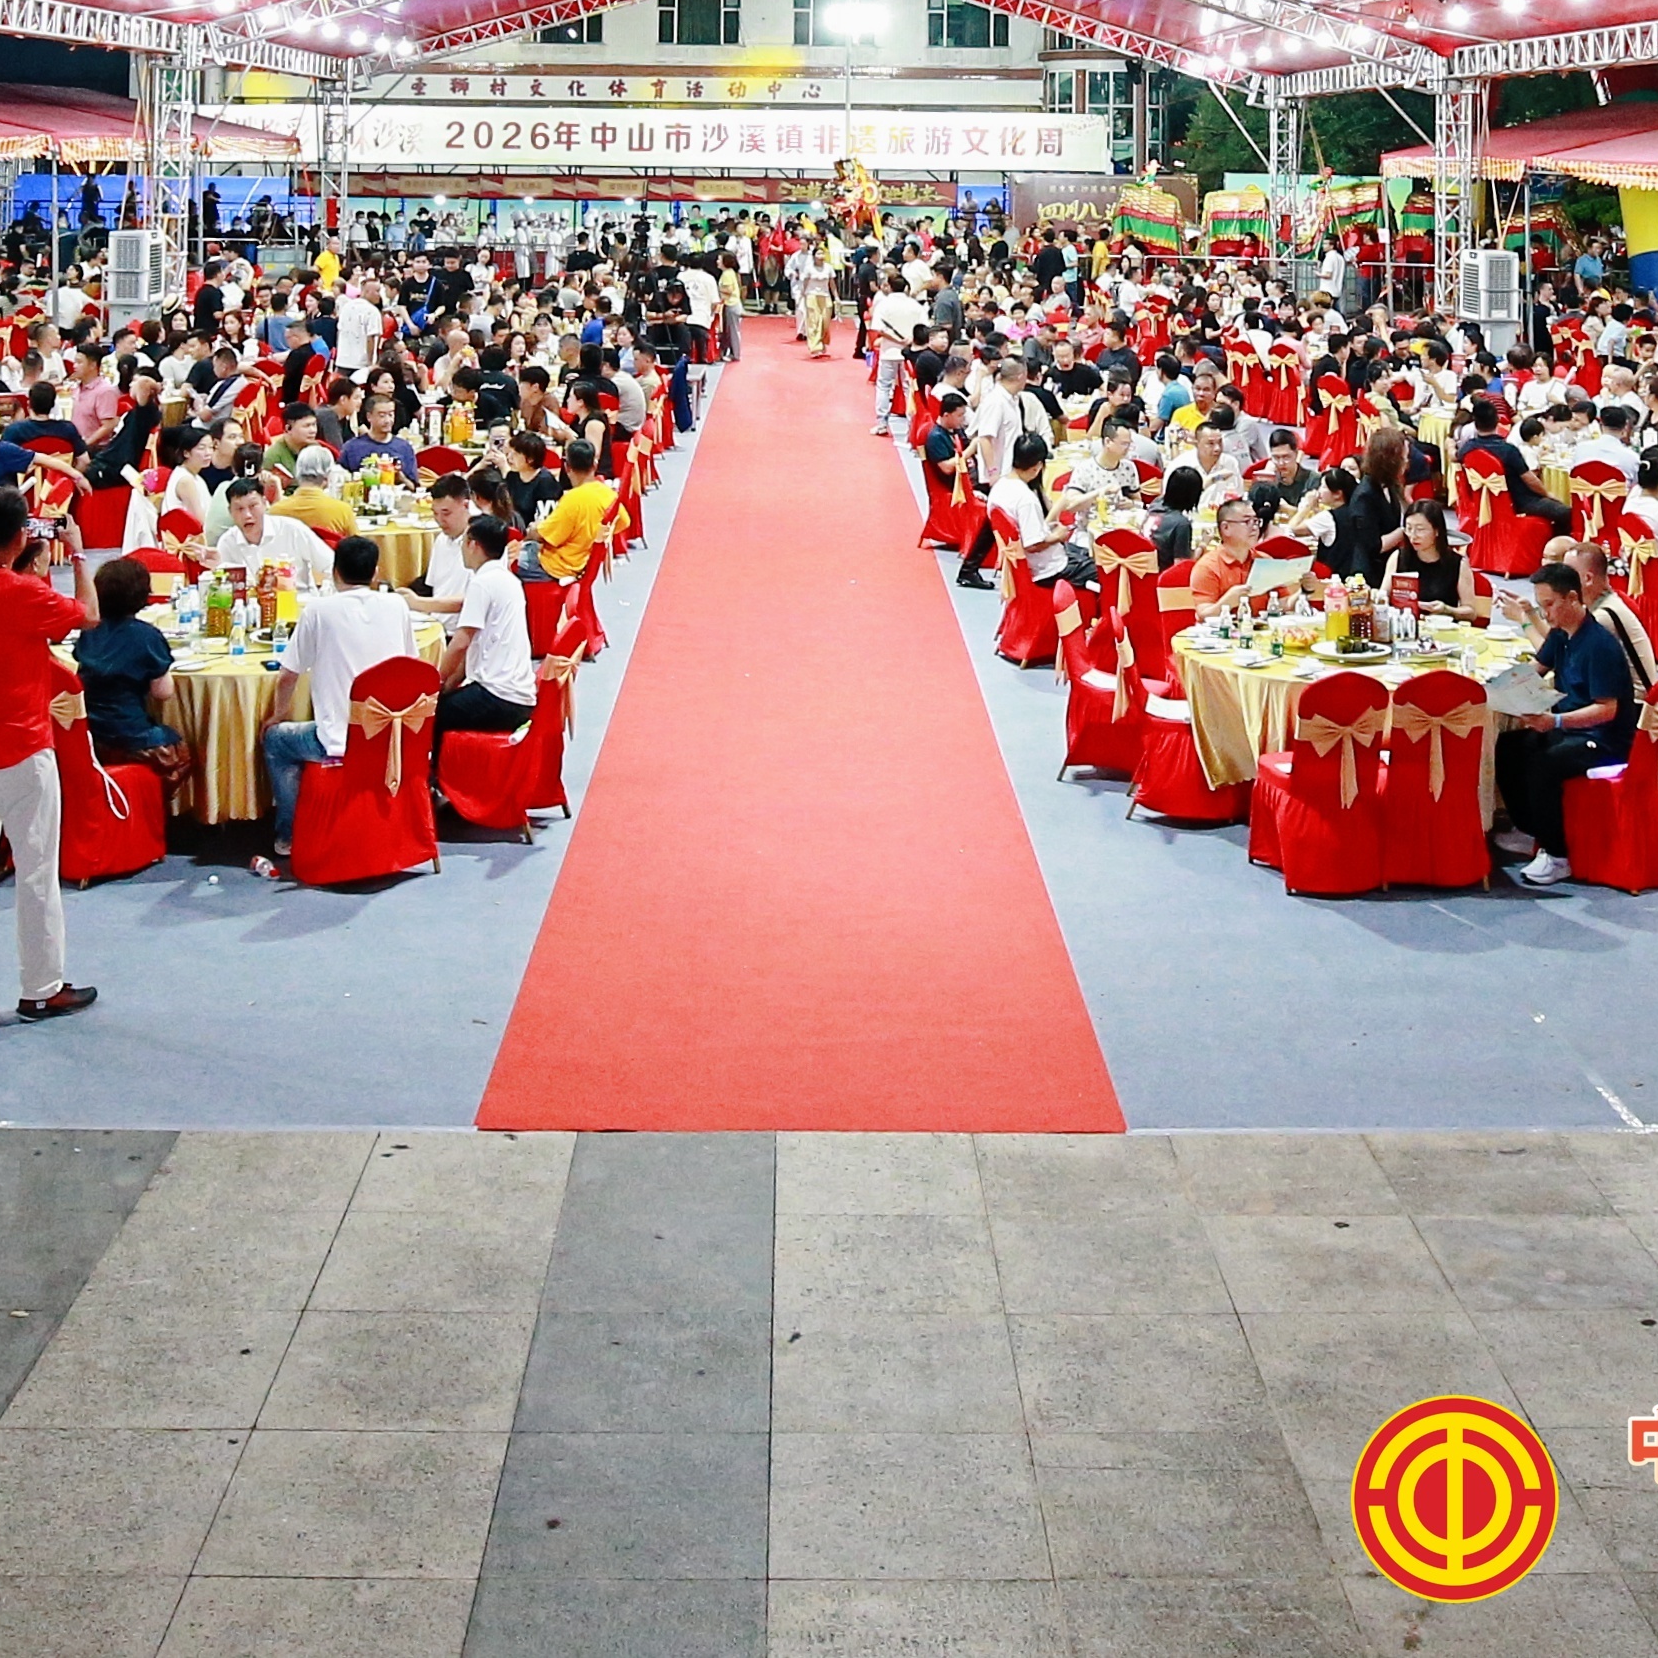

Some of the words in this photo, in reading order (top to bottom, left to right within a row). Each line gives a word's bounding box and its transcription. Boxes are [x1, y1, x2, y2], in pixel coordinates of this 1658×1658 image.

[410, 77, 822, 100] 圣狮村文化体育活动中心
[445, 120, 1063, 157] 2026年中山市沙溪镇非遗旅游文化周
